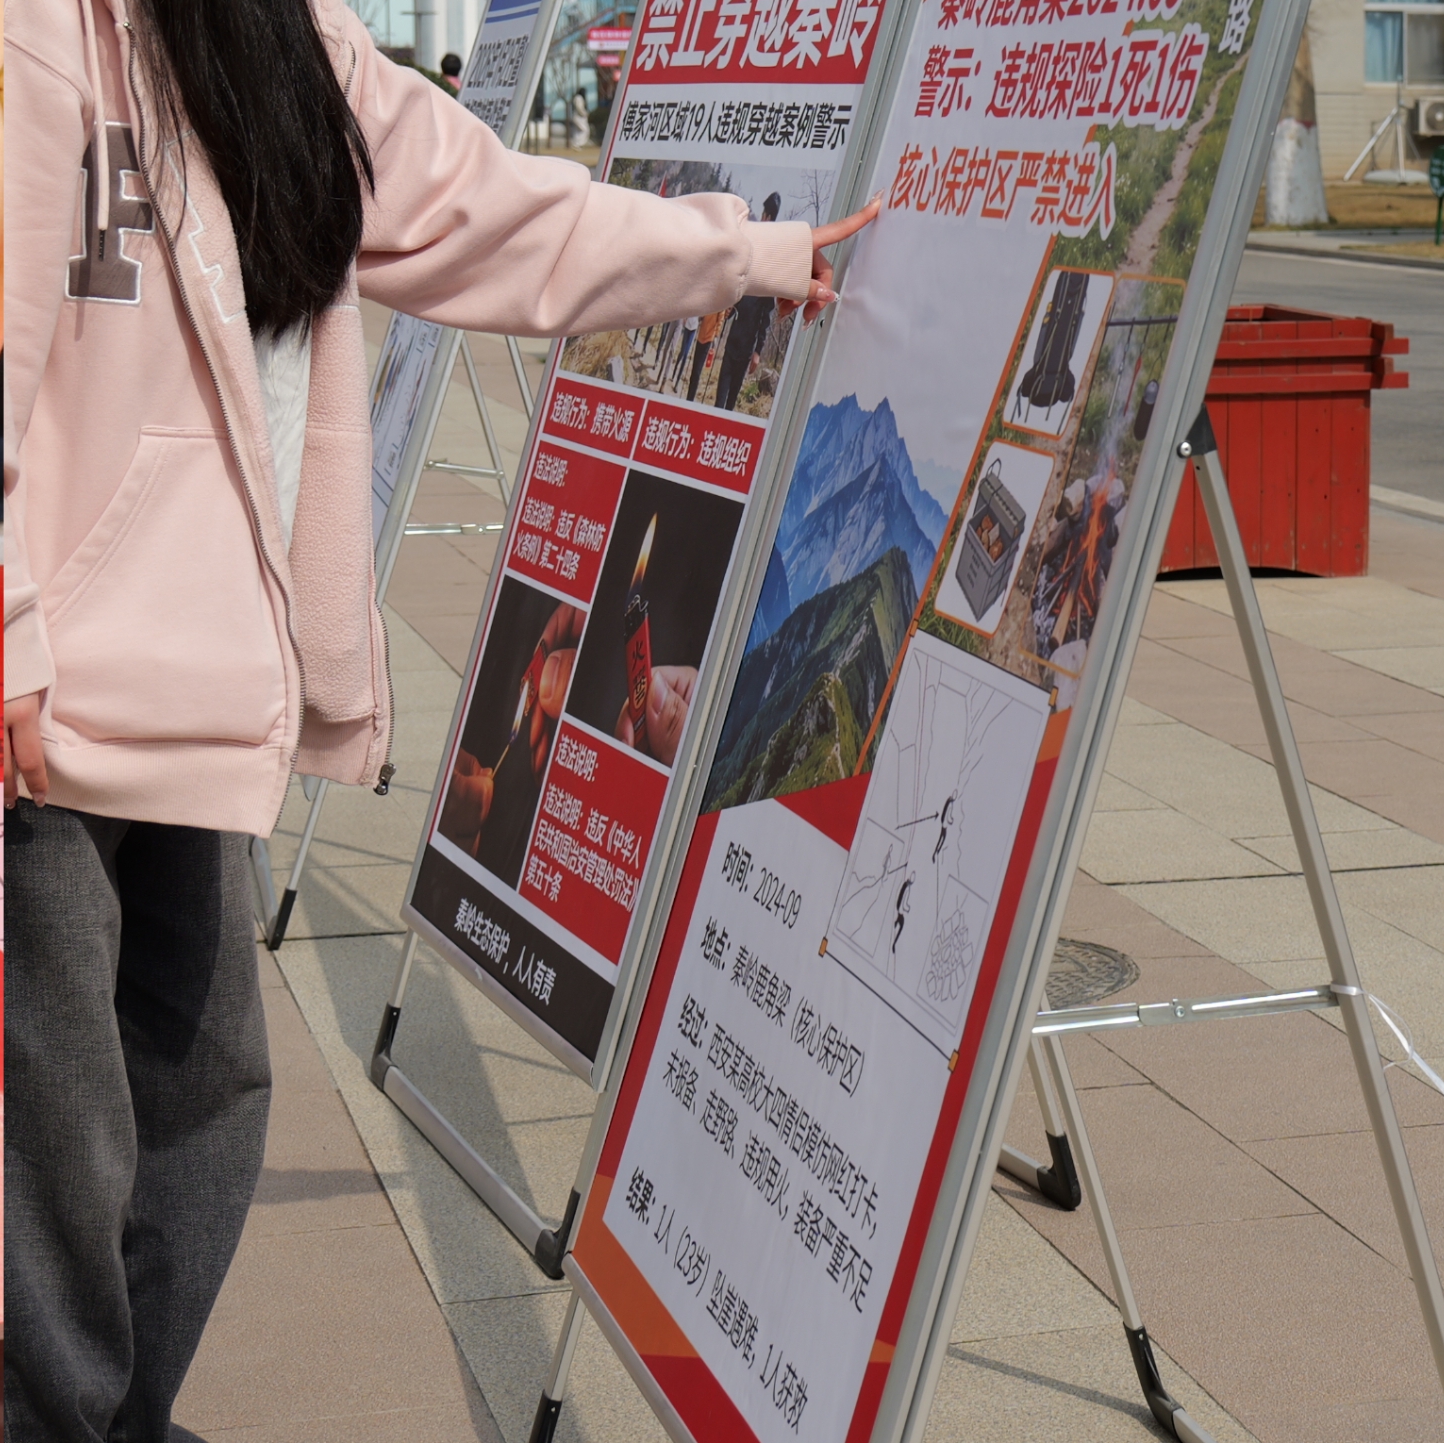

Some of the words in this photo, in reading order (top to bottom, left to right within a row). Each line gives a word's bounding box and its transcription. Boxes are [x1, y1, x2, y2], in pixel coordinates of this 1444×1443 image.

[888, 142, 1113, 231] 核心保护区严禁进入
